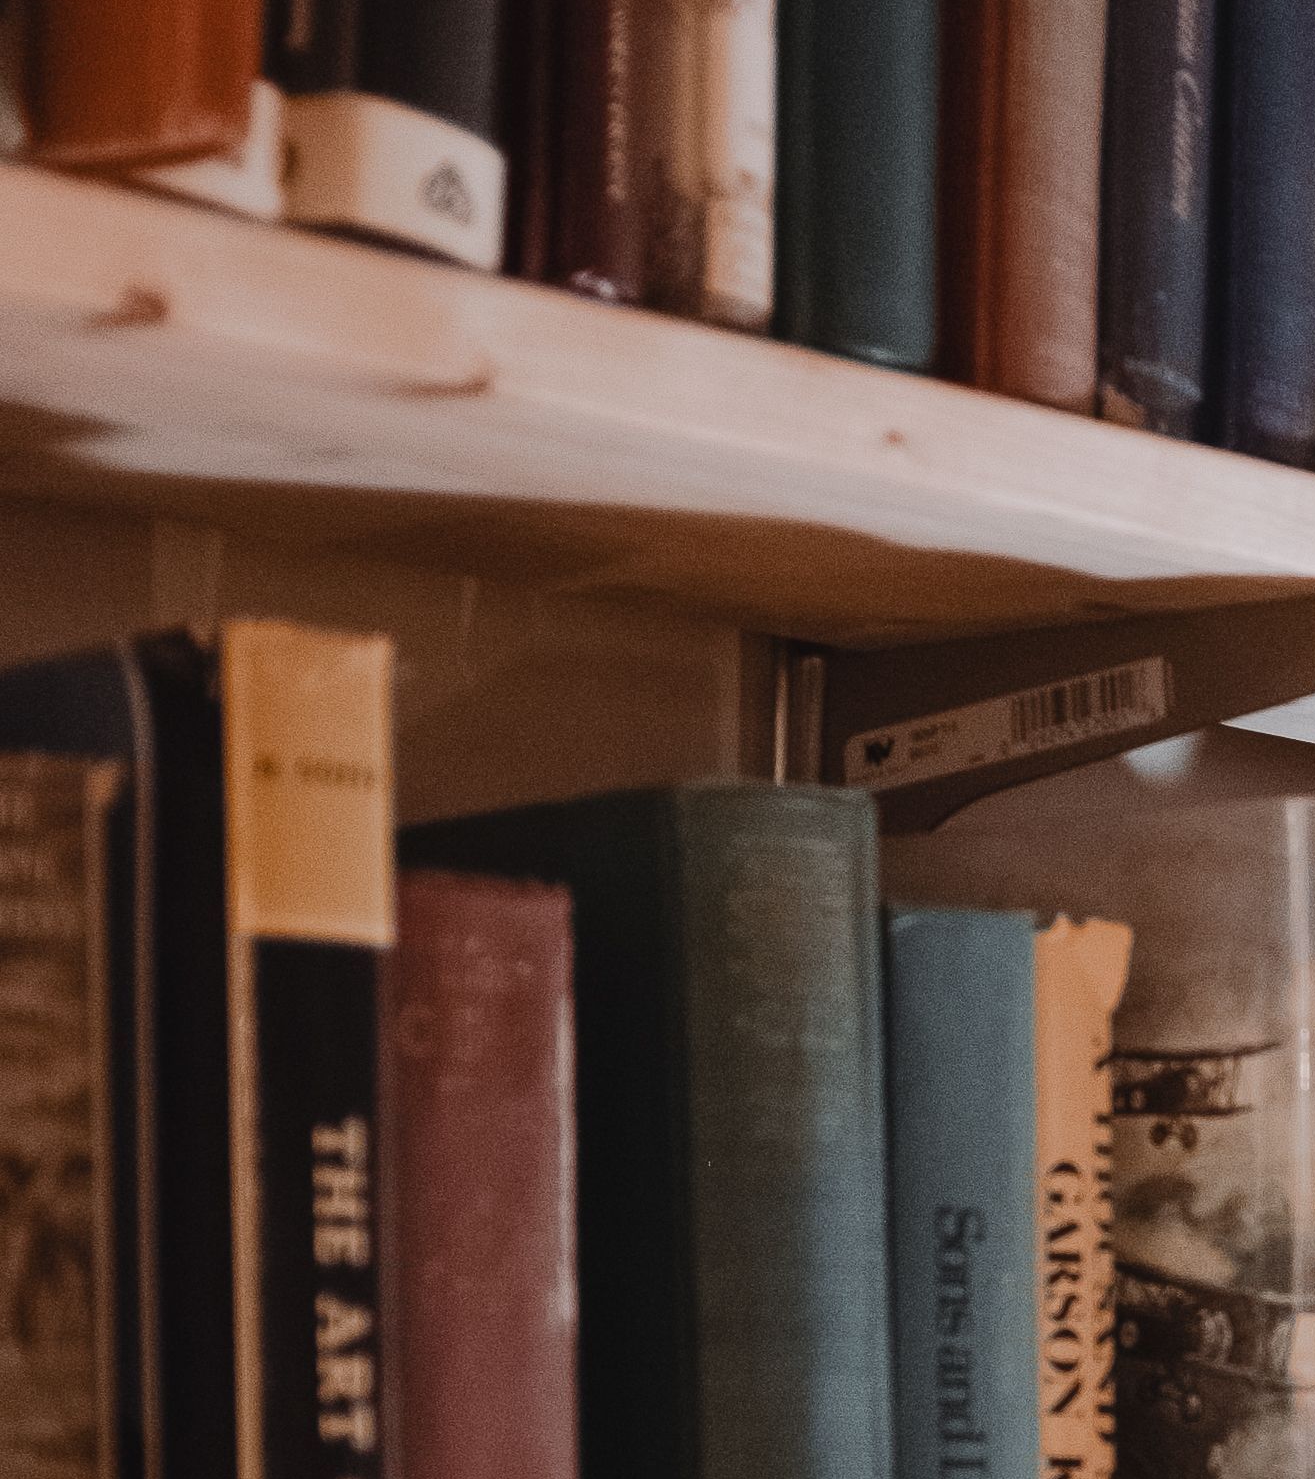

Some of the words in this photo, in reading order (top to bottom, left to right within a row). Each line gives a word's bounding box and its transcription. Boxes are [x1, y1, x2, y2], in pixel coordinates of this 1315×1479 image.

[310, 1118, 370, 1267] THE
[933, 1205, 986, 1336] Sons
[1046, 1160, 1087, 1419] GARSON
[313, 1294, 371, 1444] ART
[934, 1344, 987, 1443] and
